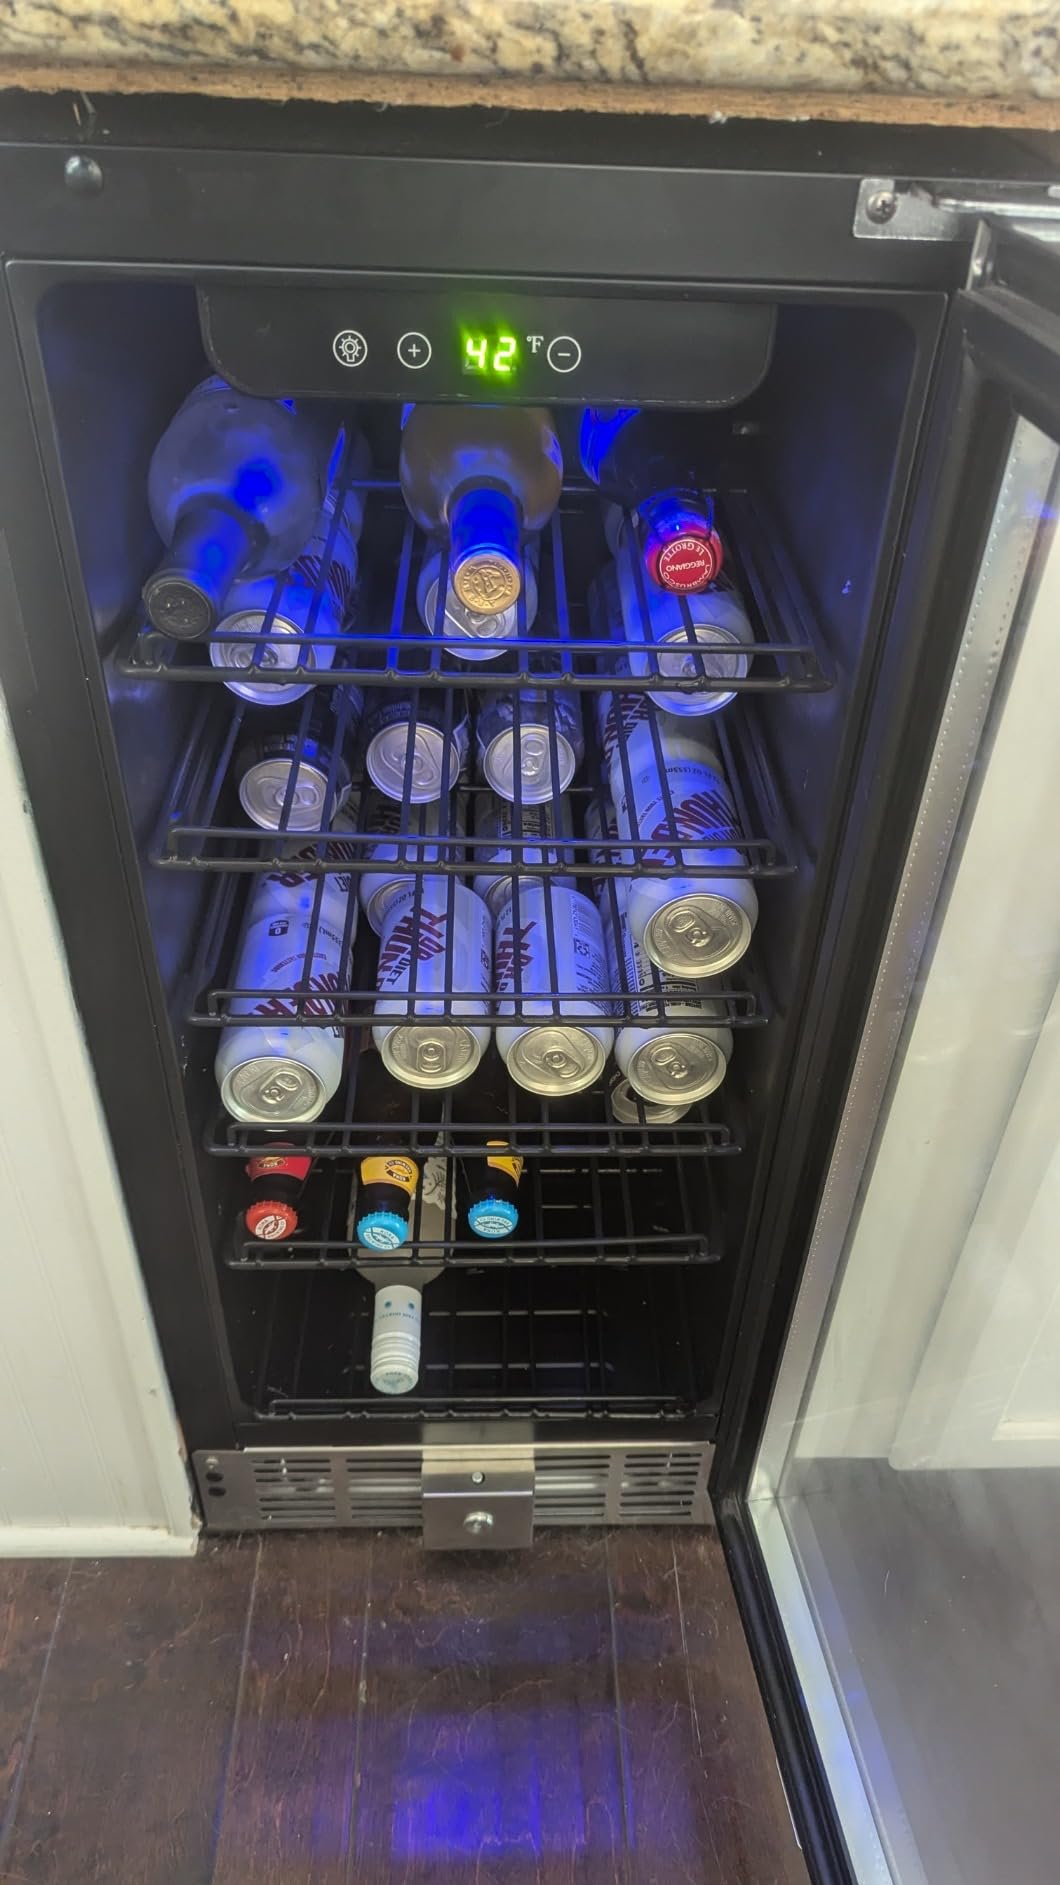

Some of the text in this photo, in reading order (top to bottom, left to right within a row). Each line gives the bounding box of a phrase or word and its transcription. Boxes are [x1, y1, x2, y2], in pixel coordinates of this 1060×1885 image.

[466, 337, 516, 371] 42
[663, 542, 705, 562] LE GROTTE
[665, 559, 705, 572] REGGIANO
[386, 957, 411, 985] DIET
[392, 1172, 406, 1181] KONA
